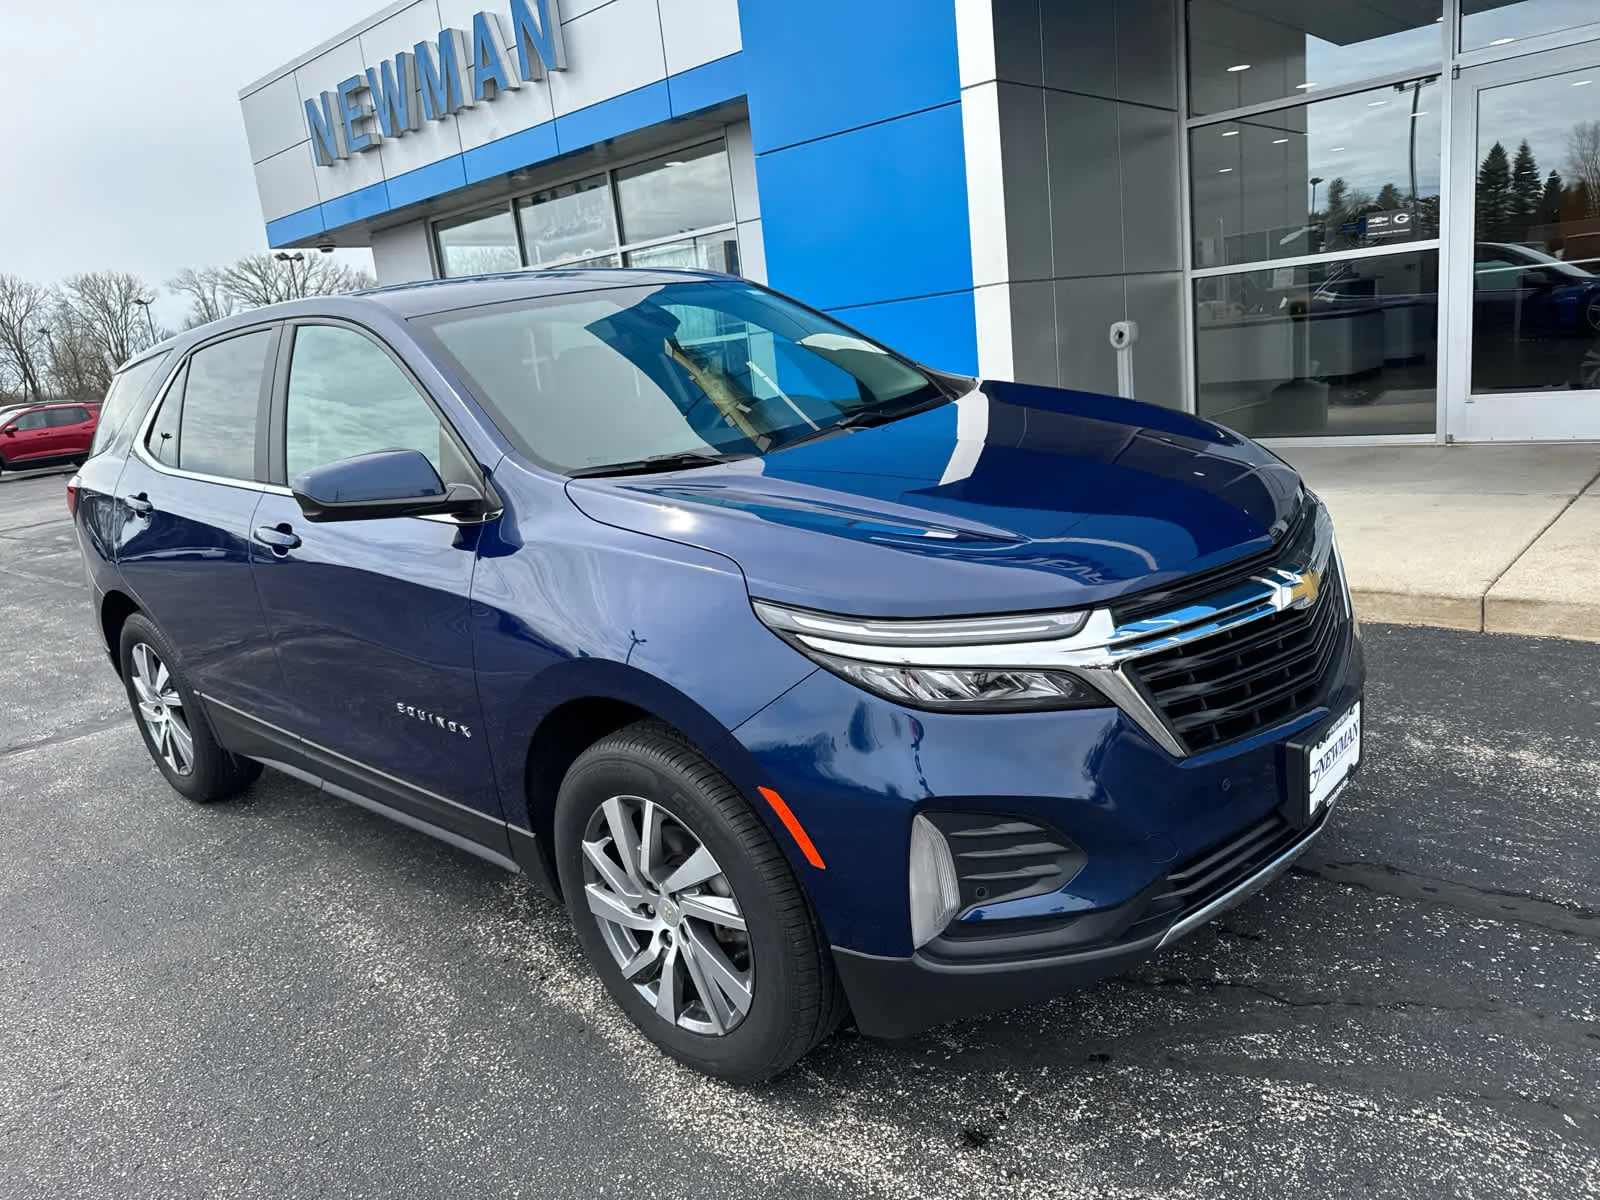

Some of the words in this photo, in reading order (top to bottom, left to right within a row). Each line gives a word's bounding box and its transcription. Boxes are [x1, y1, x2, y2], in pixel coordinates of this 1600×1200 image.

[304, 0, 567, 166] NEWMAN
[396, 702, 472, 738] EQUINOX
[1318, 720, 1359, 773] NEWMAN
